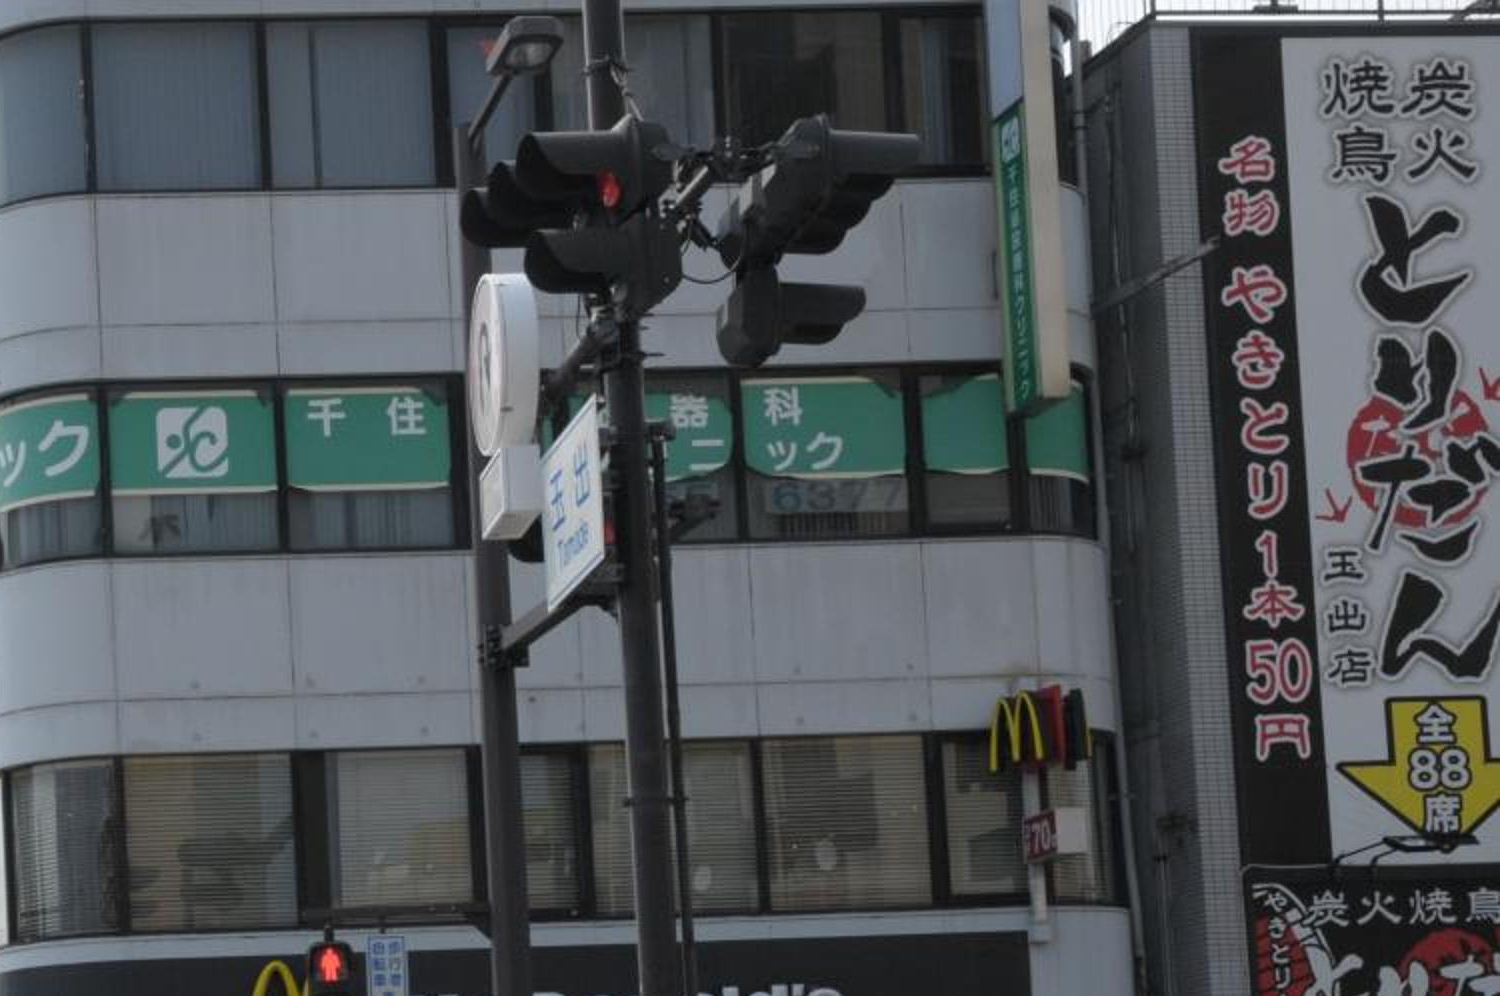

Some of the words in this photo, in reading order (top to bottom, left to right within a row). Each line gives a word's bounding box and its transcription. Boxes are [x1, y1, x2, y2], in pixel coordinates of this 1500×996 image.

[306, 396, 428, 438] 千住
[1323, 548, 1374, 684] 玉出店
